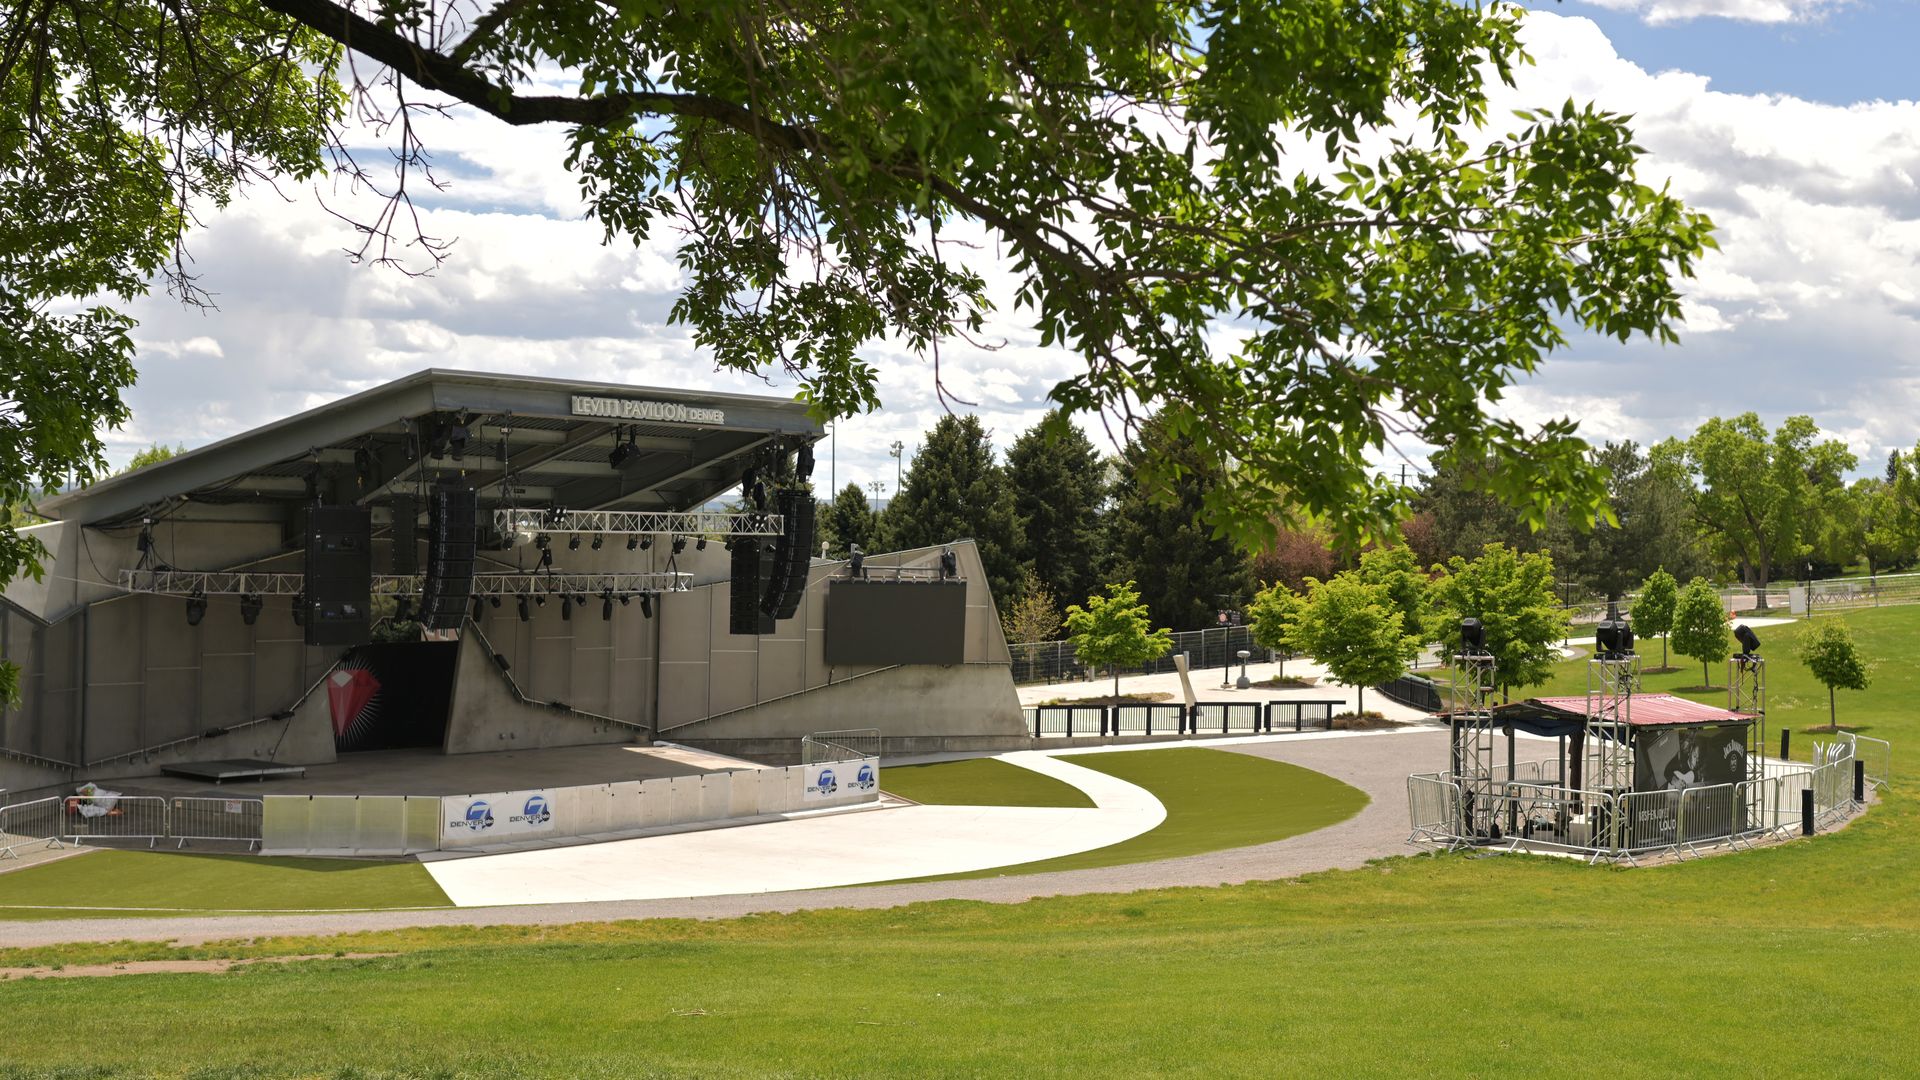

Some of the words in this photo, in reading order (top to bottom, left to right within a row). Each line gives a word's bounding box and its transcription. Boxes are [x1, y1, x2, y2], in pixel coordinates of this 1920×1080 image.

[573, 395, 620, 417] LEVITT
[622, 399, 686, 423] PAVILION
[688, 408, 724, 425] DENVER
[509, 814, 540, 822] DENVER
[450, 819, 483, 828] DENVER
